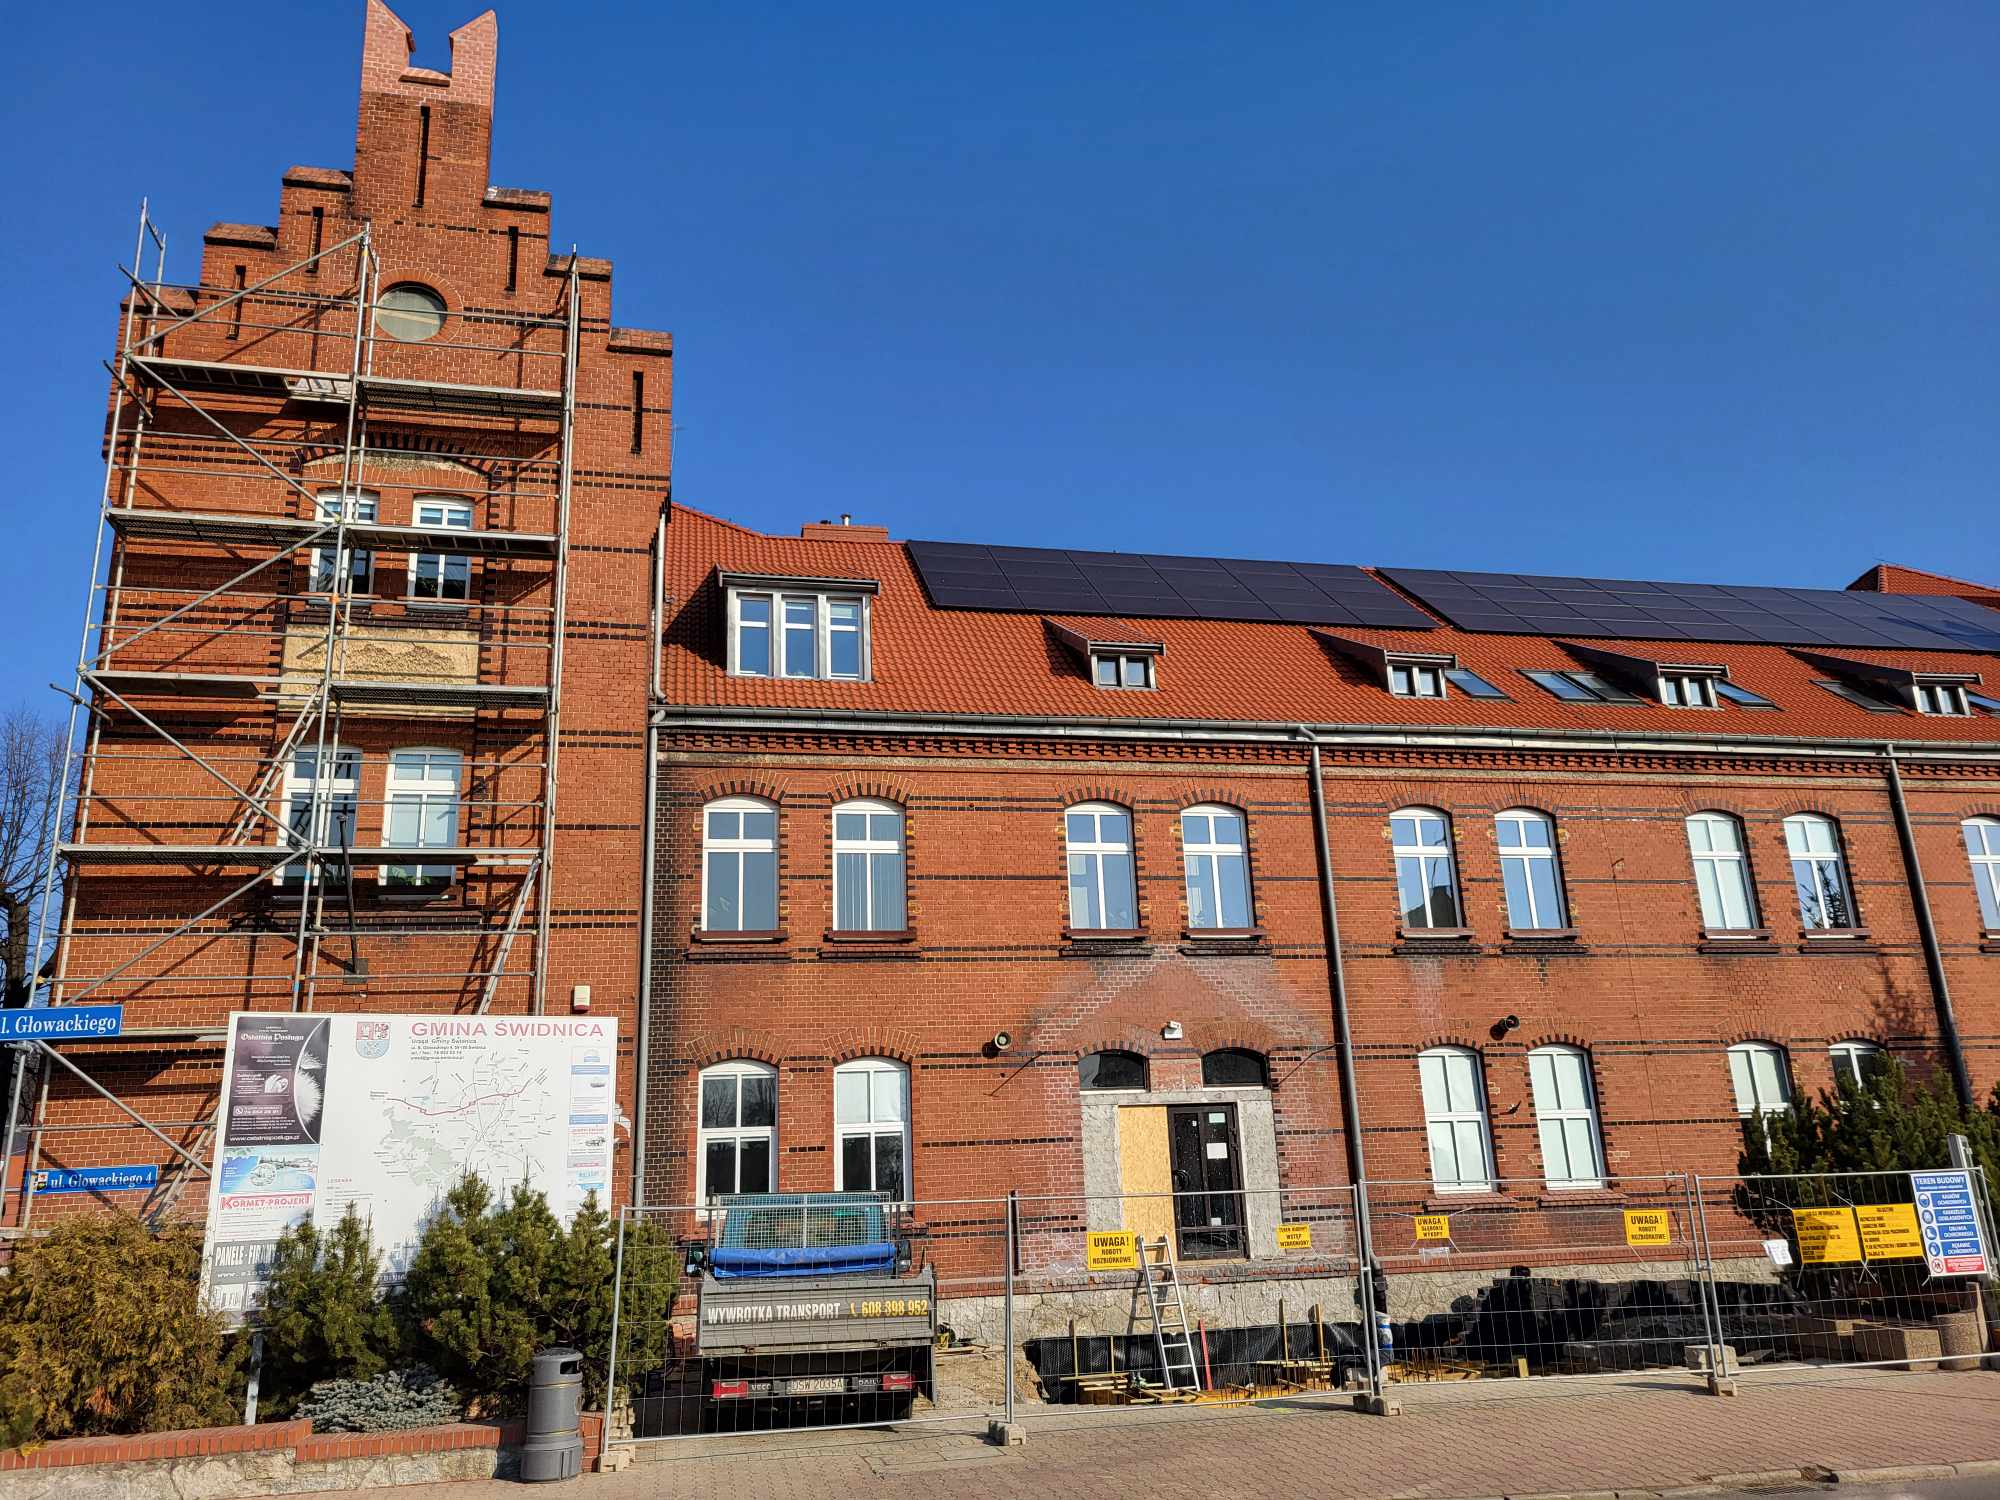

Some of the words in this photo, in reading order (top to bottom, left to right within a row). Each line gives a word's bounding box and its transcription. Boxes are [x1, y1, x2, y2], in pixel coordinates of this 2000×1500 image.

[15, 1013, 116, 1034] Głowackiego
[411, 1022, 487, 1036] GMINA
[494, 1019, 603, 1037] ŚWIDNICA
[51, 1174, 65, 1188] ul.
[68, 1171, 142, 1188] Głowackiego
[145, 1172, 152, 1184] 4
[1936, 1176, 1965, 1184] BUDOWY
[707, 1306, 773, 1324] WYWROTKA
[775, 1302, 841, 1321] TRANSPORT
[861, 1301, 881, 1317] 608
[907, 1299, 928, 1316] 952
